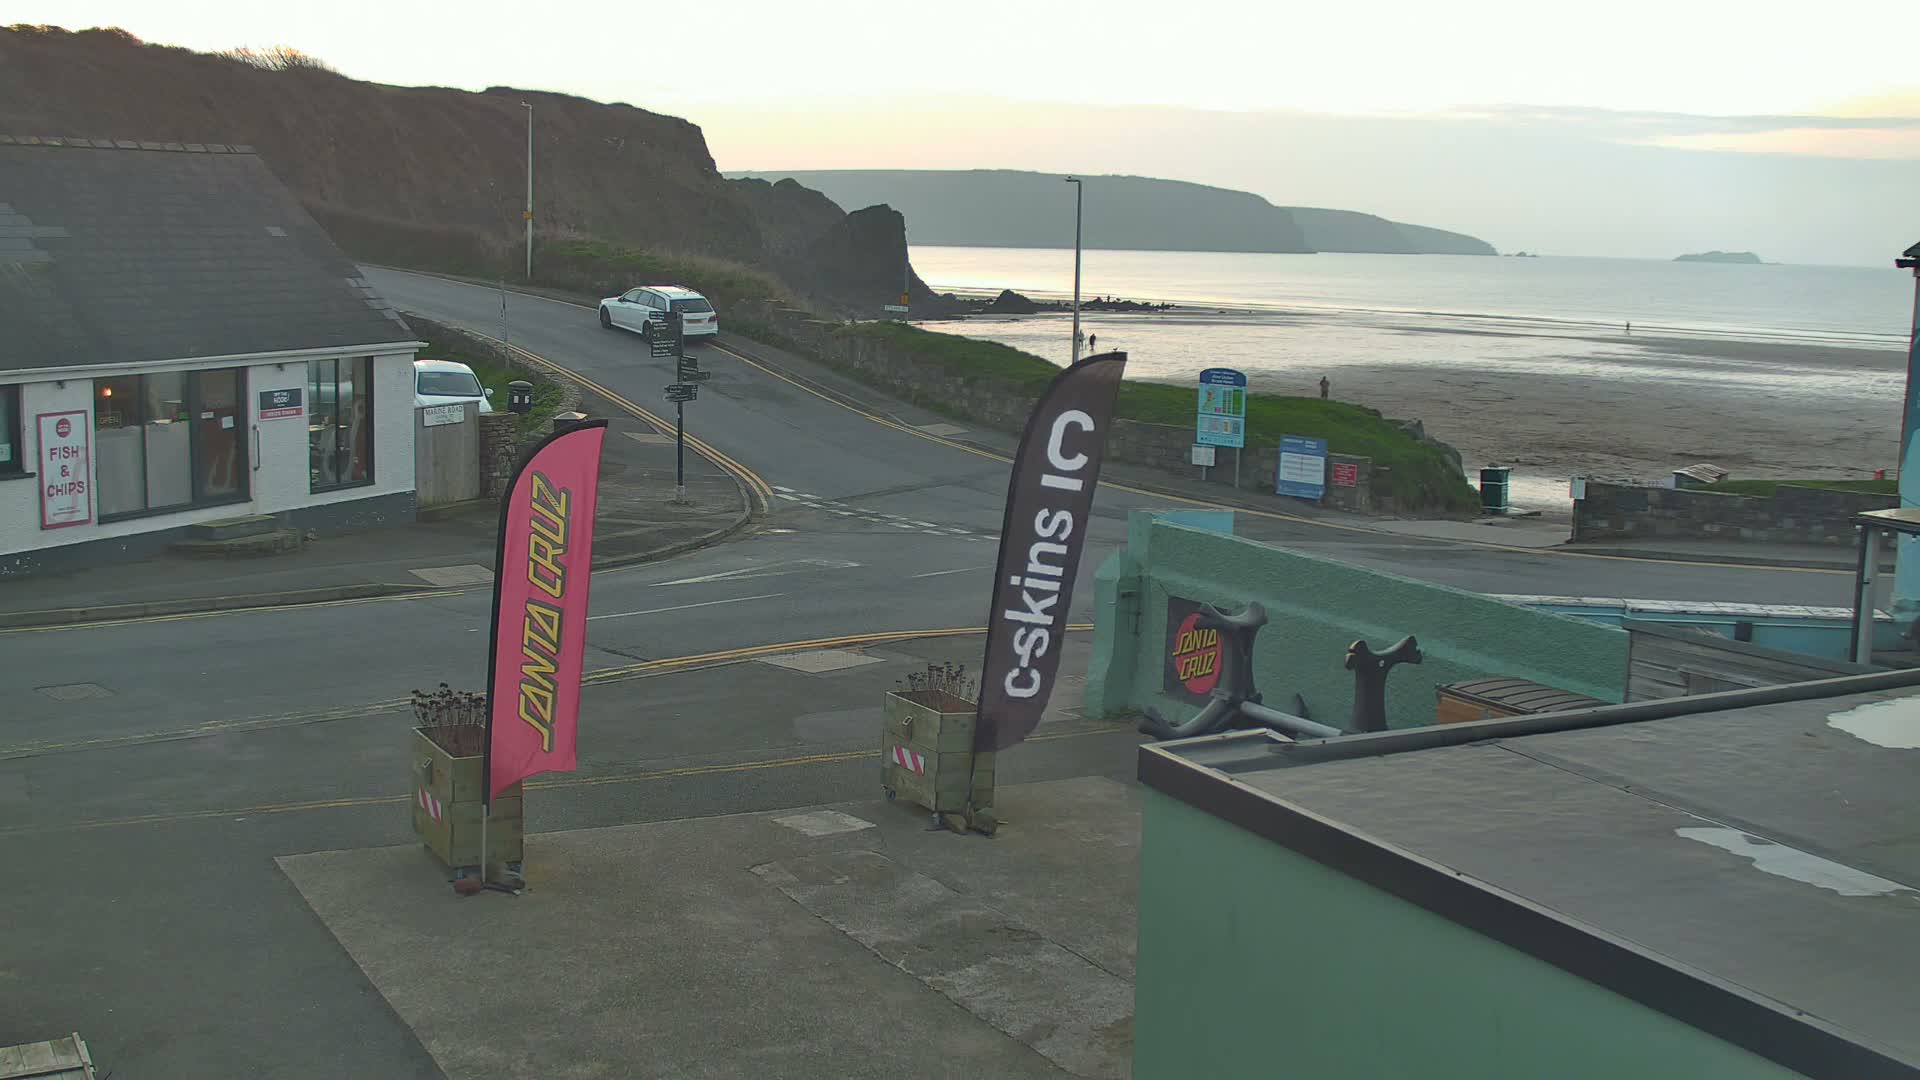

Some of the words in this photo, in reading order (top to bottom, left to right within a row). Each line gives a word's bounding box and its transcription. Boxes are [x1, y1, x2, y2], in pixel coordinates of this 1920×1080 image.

[425, 407, 447, 416] MARINE
[447, 405, 463, 414] ROAD
[50, 446, 79, 461] FISH
[60, 464, 70, 478] &
[47, 481, 85, 497] CHIPS
[527, 471, 571, 598] CRUZ
[1172, 628, 1217, 656] SANTA
[518, 600, 564, 752] SANTA
[1179, 651, 1217, 681] CRUZ
